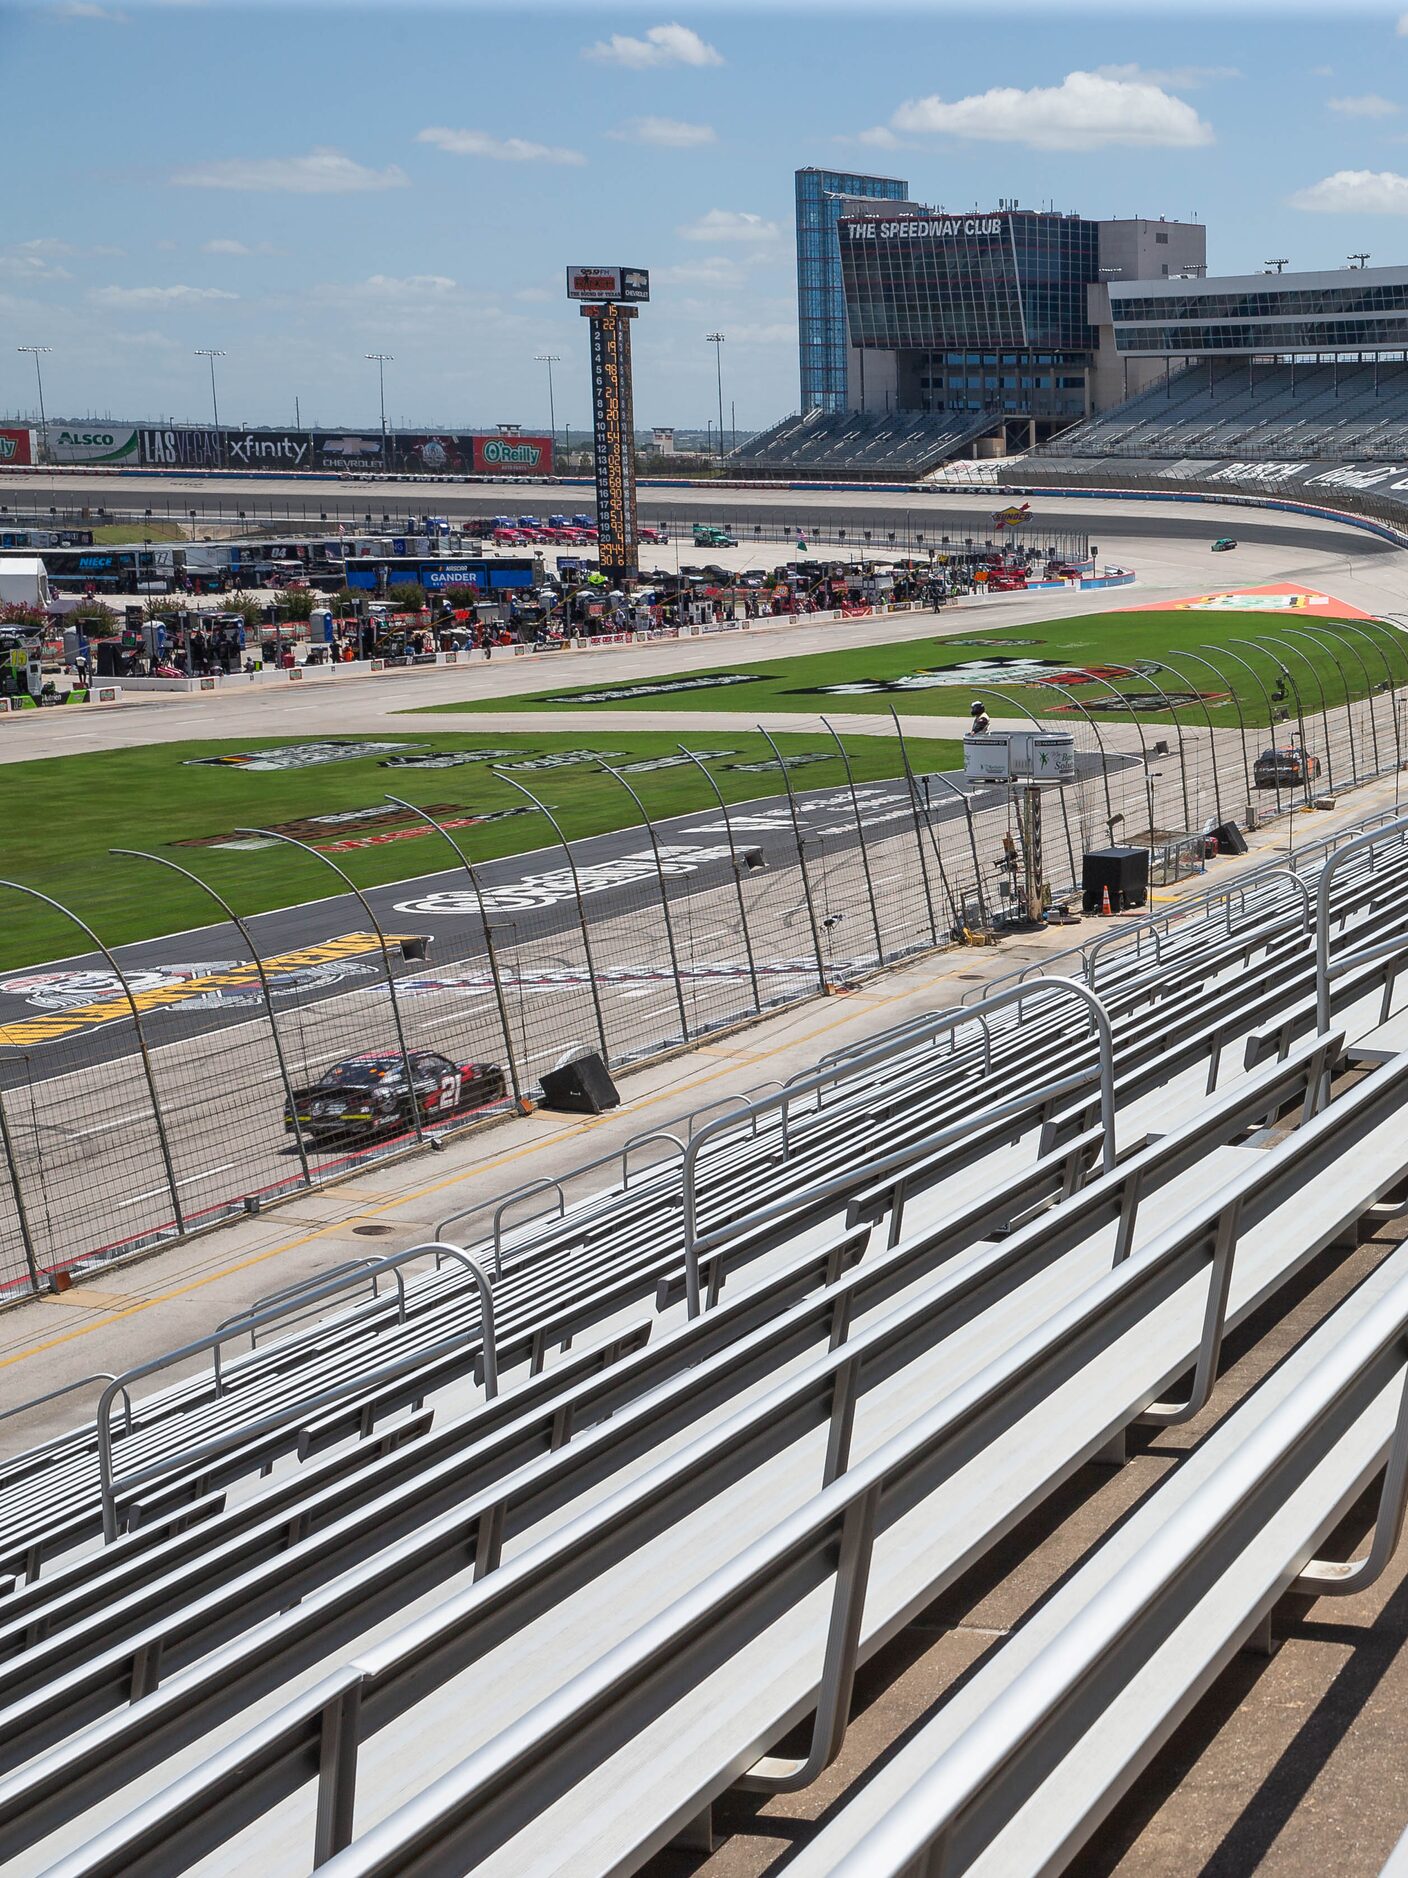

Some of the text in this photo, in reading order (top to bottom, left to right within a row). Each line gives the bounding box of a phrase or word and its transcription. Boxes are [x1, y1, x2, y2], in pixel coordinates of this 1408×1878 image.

[848, 218, 1001, 239] THE SPEEDWAY CLUB
[594, 319, 615, 330] 1 22
[594, 332, 600, 340] 2
[595, 341, 616, 352] 3 19
[595, 354, 601, 362] 4
[596, 364, 617, 375] 5 98
[596, 375, 617, 386] 6 9
[597, 388, 602, 396] 7
[597, 400, 603, 408] 8
[598, 411, 603, 419] 9
[596, 422, 605, 430] 10
[57, 431, 114, 446] ALSCO
[598, 432, 619, 443] 11 54
[145, 431, 176, 463] LAS
[230, 435, 307, 464] xfinity
[485, 440, 540, 464] O'Reilly
[597, 443, 620, 454] 12 8
[322, 458, 384, 468] CHEVROLET
[598, 456, 607, 464] 13
[598, 467, 607, 475] 14
[1206, 462, 1310, 482] BUSCH
[397, 475, 465, 483] LIMITS
[483, 476, 543, 484] TEXAS
[599, 489, 608, 497] 16
[944, 486, 999, 494] TEXAS
[995, 512, 1032, 523] SUNOCO
[600, 523, 610, 531] 19
[600, 534, 610, 542] 20
[271, 548, 287, 558] 04
[79, 557, 113, 568] NIECE
[430, 572, 477, 582] GANDER
[440, 1074, 462, 1110] 21
